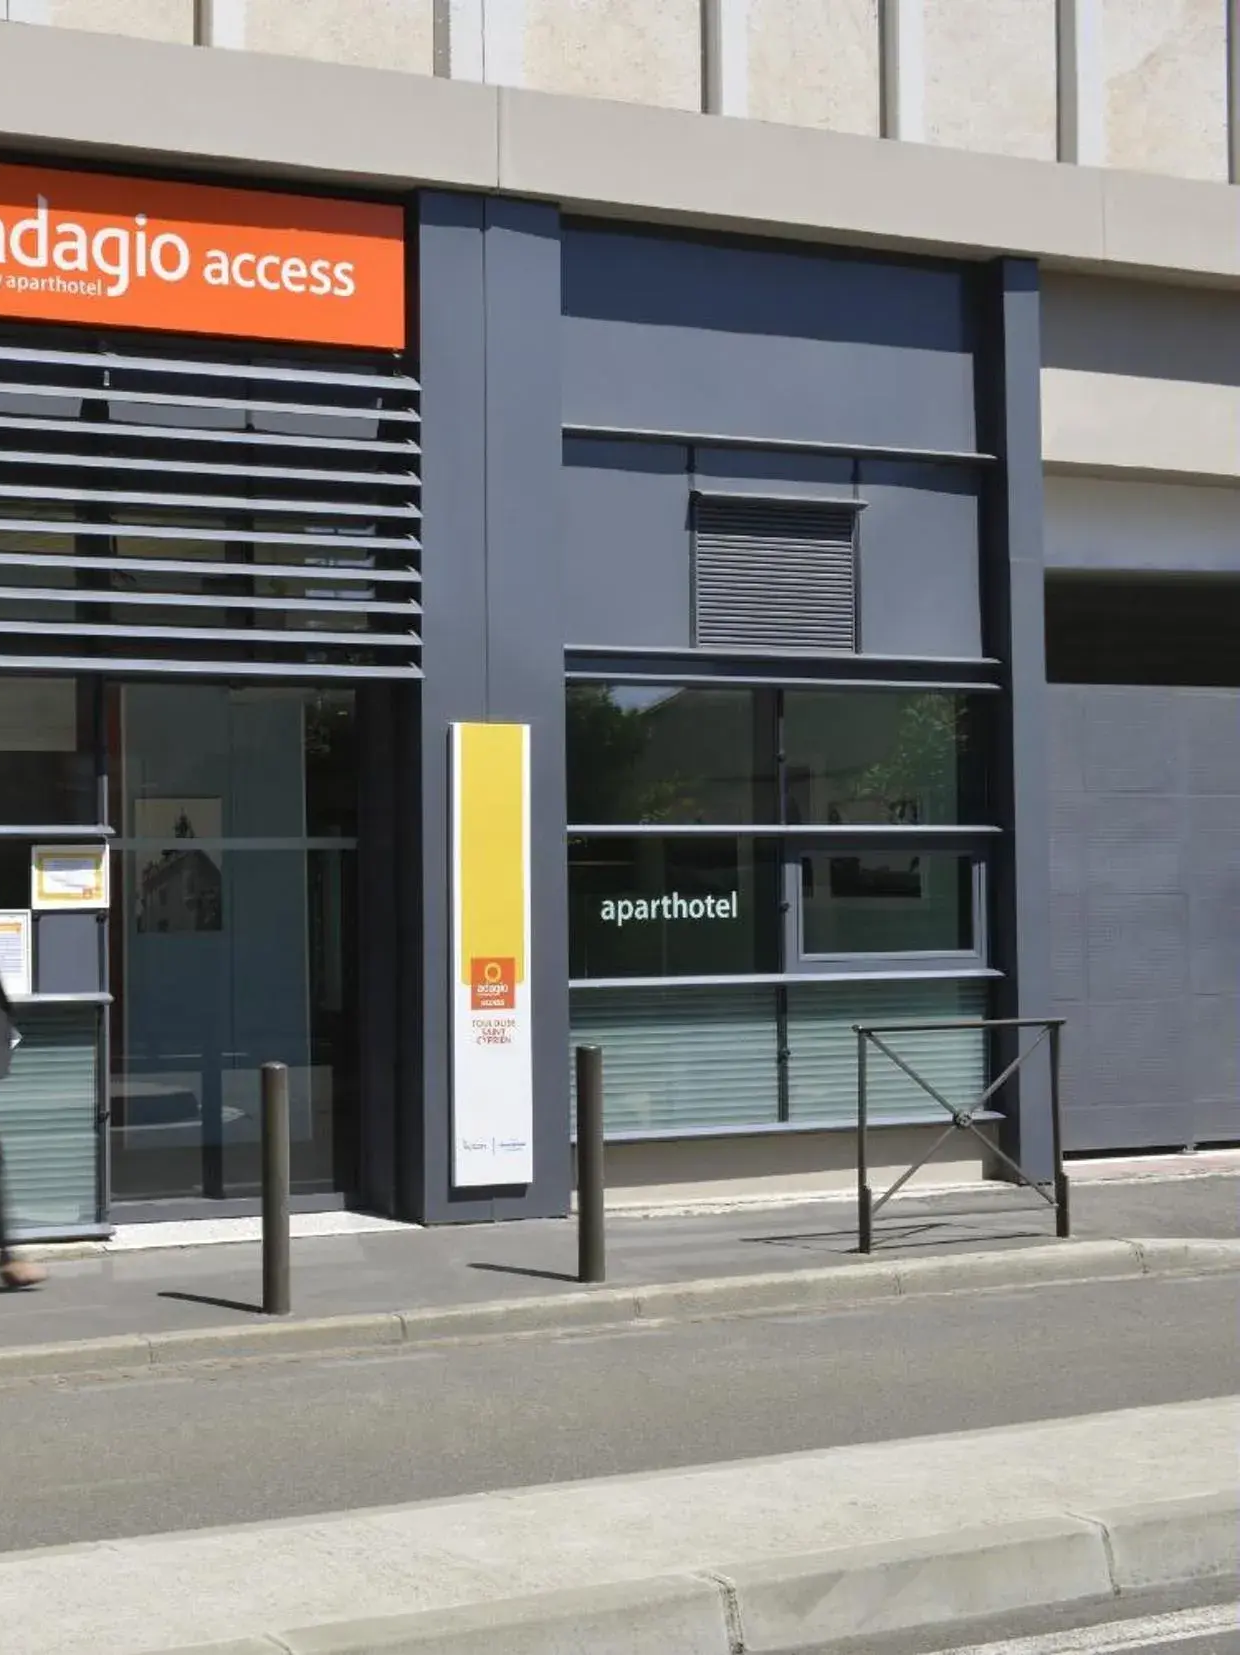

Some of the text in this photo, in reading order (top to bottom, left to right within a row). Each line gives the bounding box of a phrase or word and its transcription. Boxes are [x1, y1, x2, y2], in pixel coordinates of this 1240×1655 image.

[6, 274, 102, 296] aparthotel
[203, 249, 355, 297] access
[600, 890, 738, 927] aparthotel
